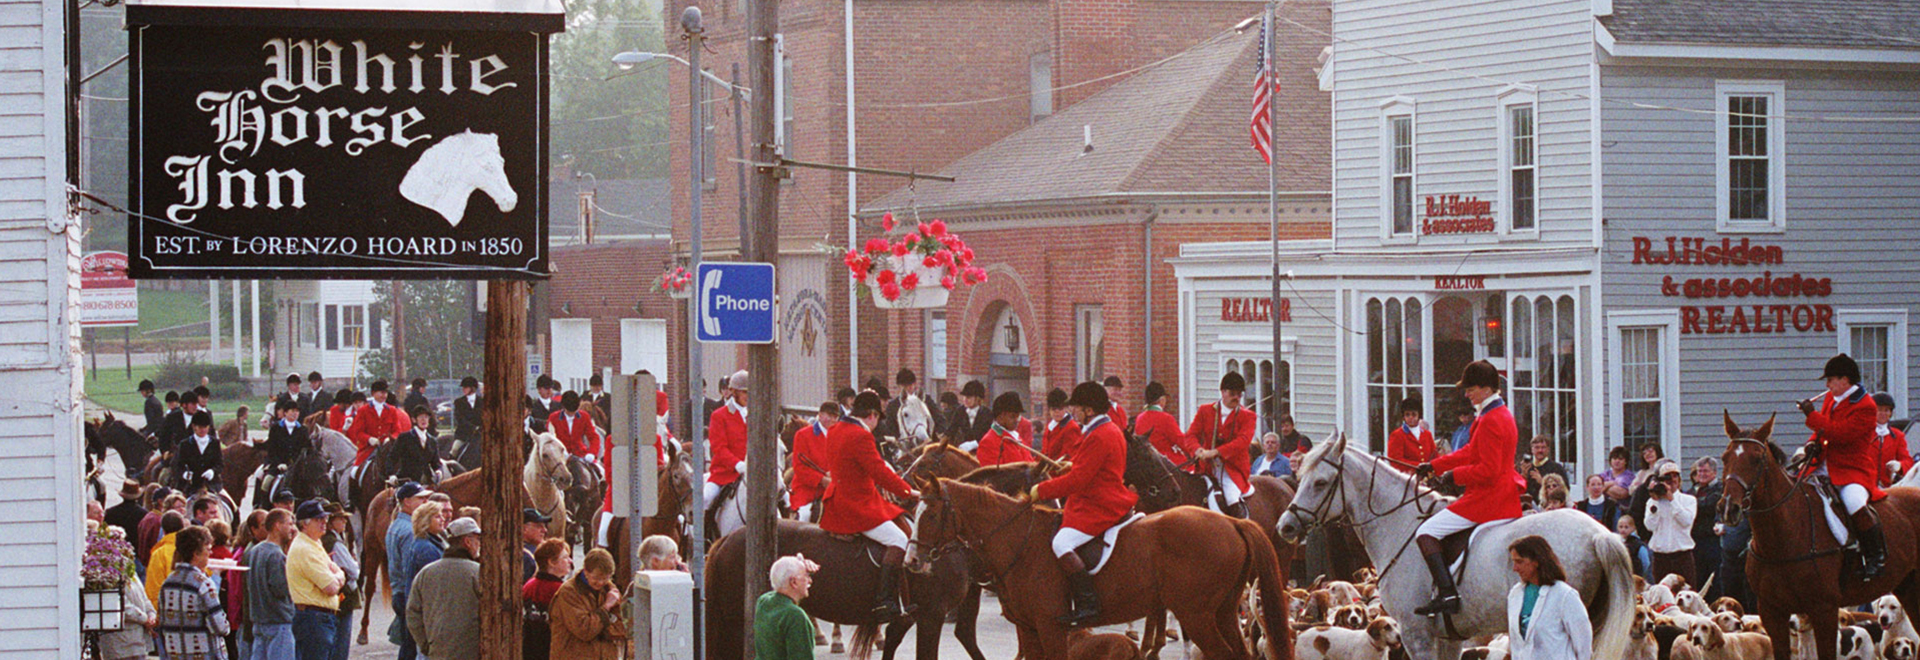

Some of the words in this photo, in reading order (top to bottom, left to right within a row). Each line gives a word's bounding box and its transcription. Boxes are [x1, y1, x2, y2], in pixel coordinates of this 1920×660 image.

[261, 37, 517, 103] White
[196, 87, 432, 164] Horse
[164, 154, 307, 224] Inn
[155, 236, 201, 255] EST.
[206, 240, 223, 251] BY
[233, 236, 357, 255] LORENZO
[368, 236, 456, 255] HOARD
[461, 240, 476, 251] IN
[479, 236, 523, 255] 1850
[1434, 275, 1485, 289] REALTOR
[1661, 275, 1679, 296] &
[1683, 270, 1832, 298] associates
[715, 294, 770, 311] Phone
[1680, 304, 1836, 333] REALTOR
